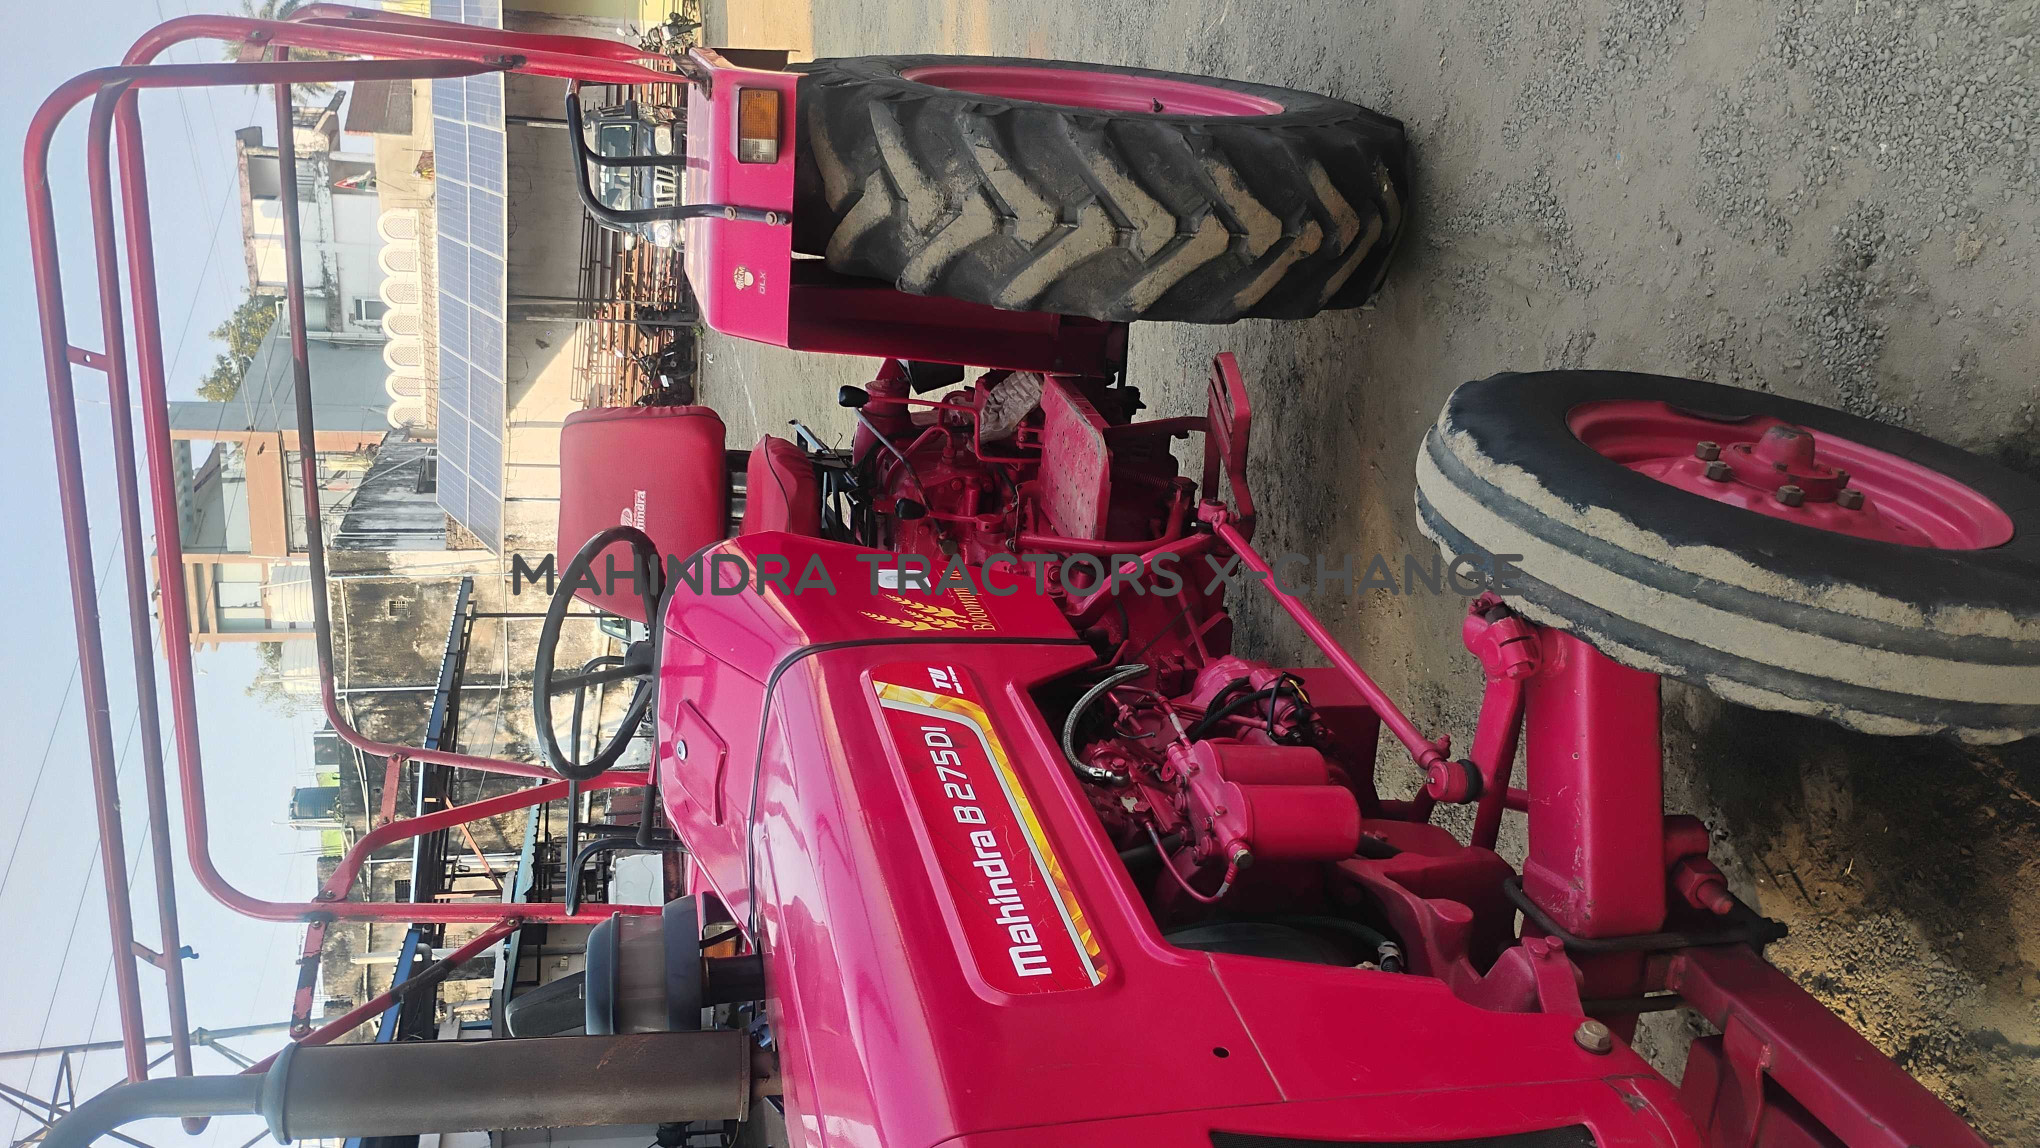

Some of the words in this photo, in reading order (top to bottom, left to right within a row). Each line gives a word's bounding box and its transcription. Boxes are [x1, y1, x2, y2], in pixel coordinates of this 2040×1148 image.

[927, 666, 951, 689] TU
[952, 805, 988, 825] B
[970, 830, 1053, 977] Mahindra
